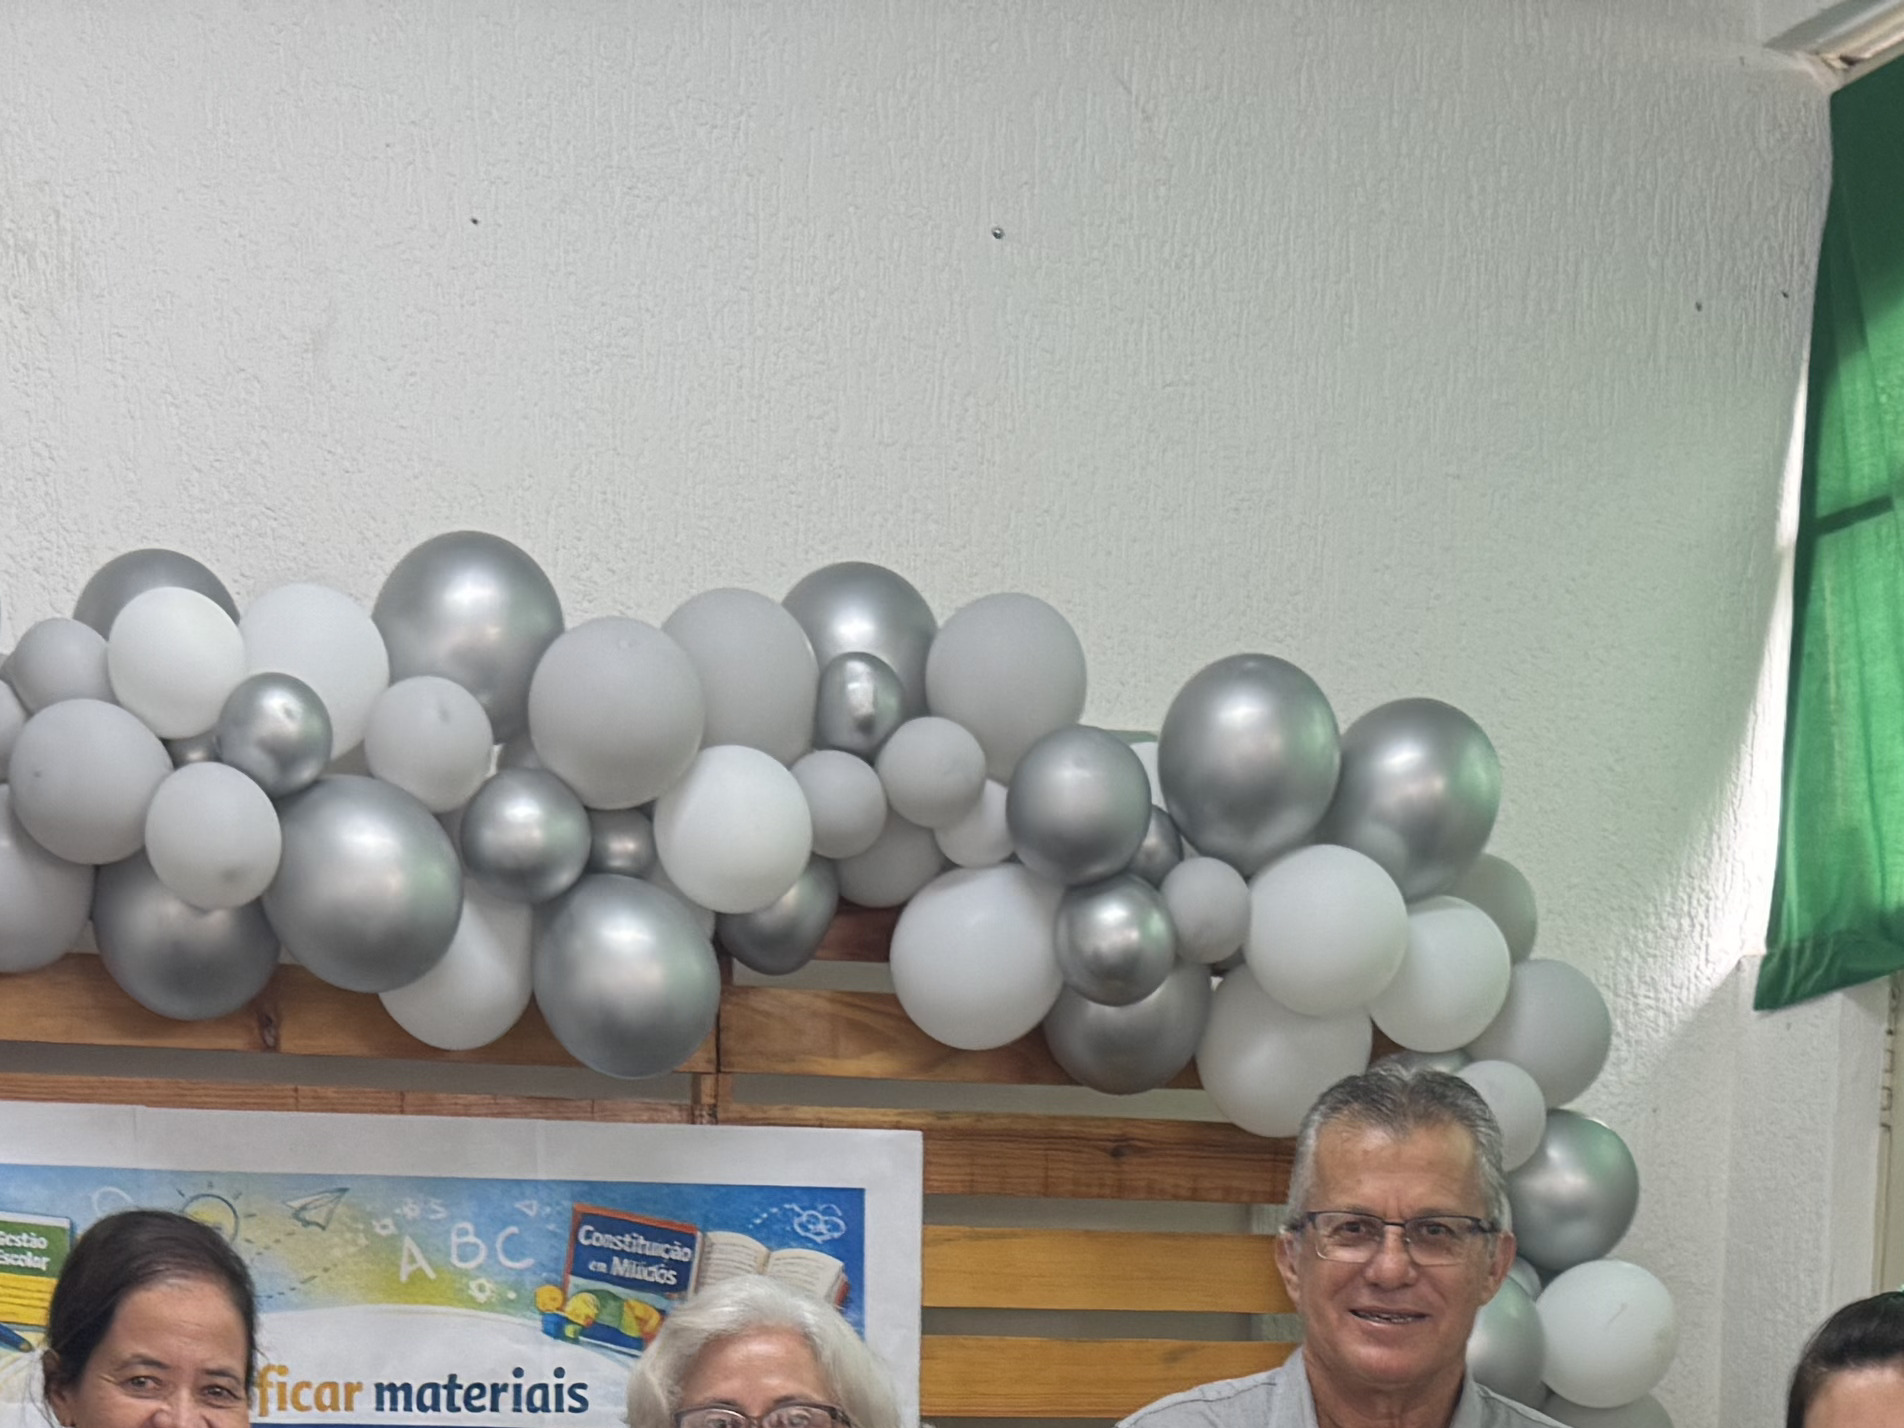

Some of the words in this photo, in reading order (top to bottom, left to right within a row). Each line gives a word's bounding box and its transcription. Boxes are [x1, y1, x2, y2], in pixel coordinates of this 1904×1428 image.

[399, 1234, 438, 1283] A
[450, 1220, 489, 1270] B
[496, 1224, 536, 1270] C
[577, 1224, 694, 1265] Constituição
[254, 1364, 364, 1418] ficar
[374, 1366, 590, 1415] materiais
